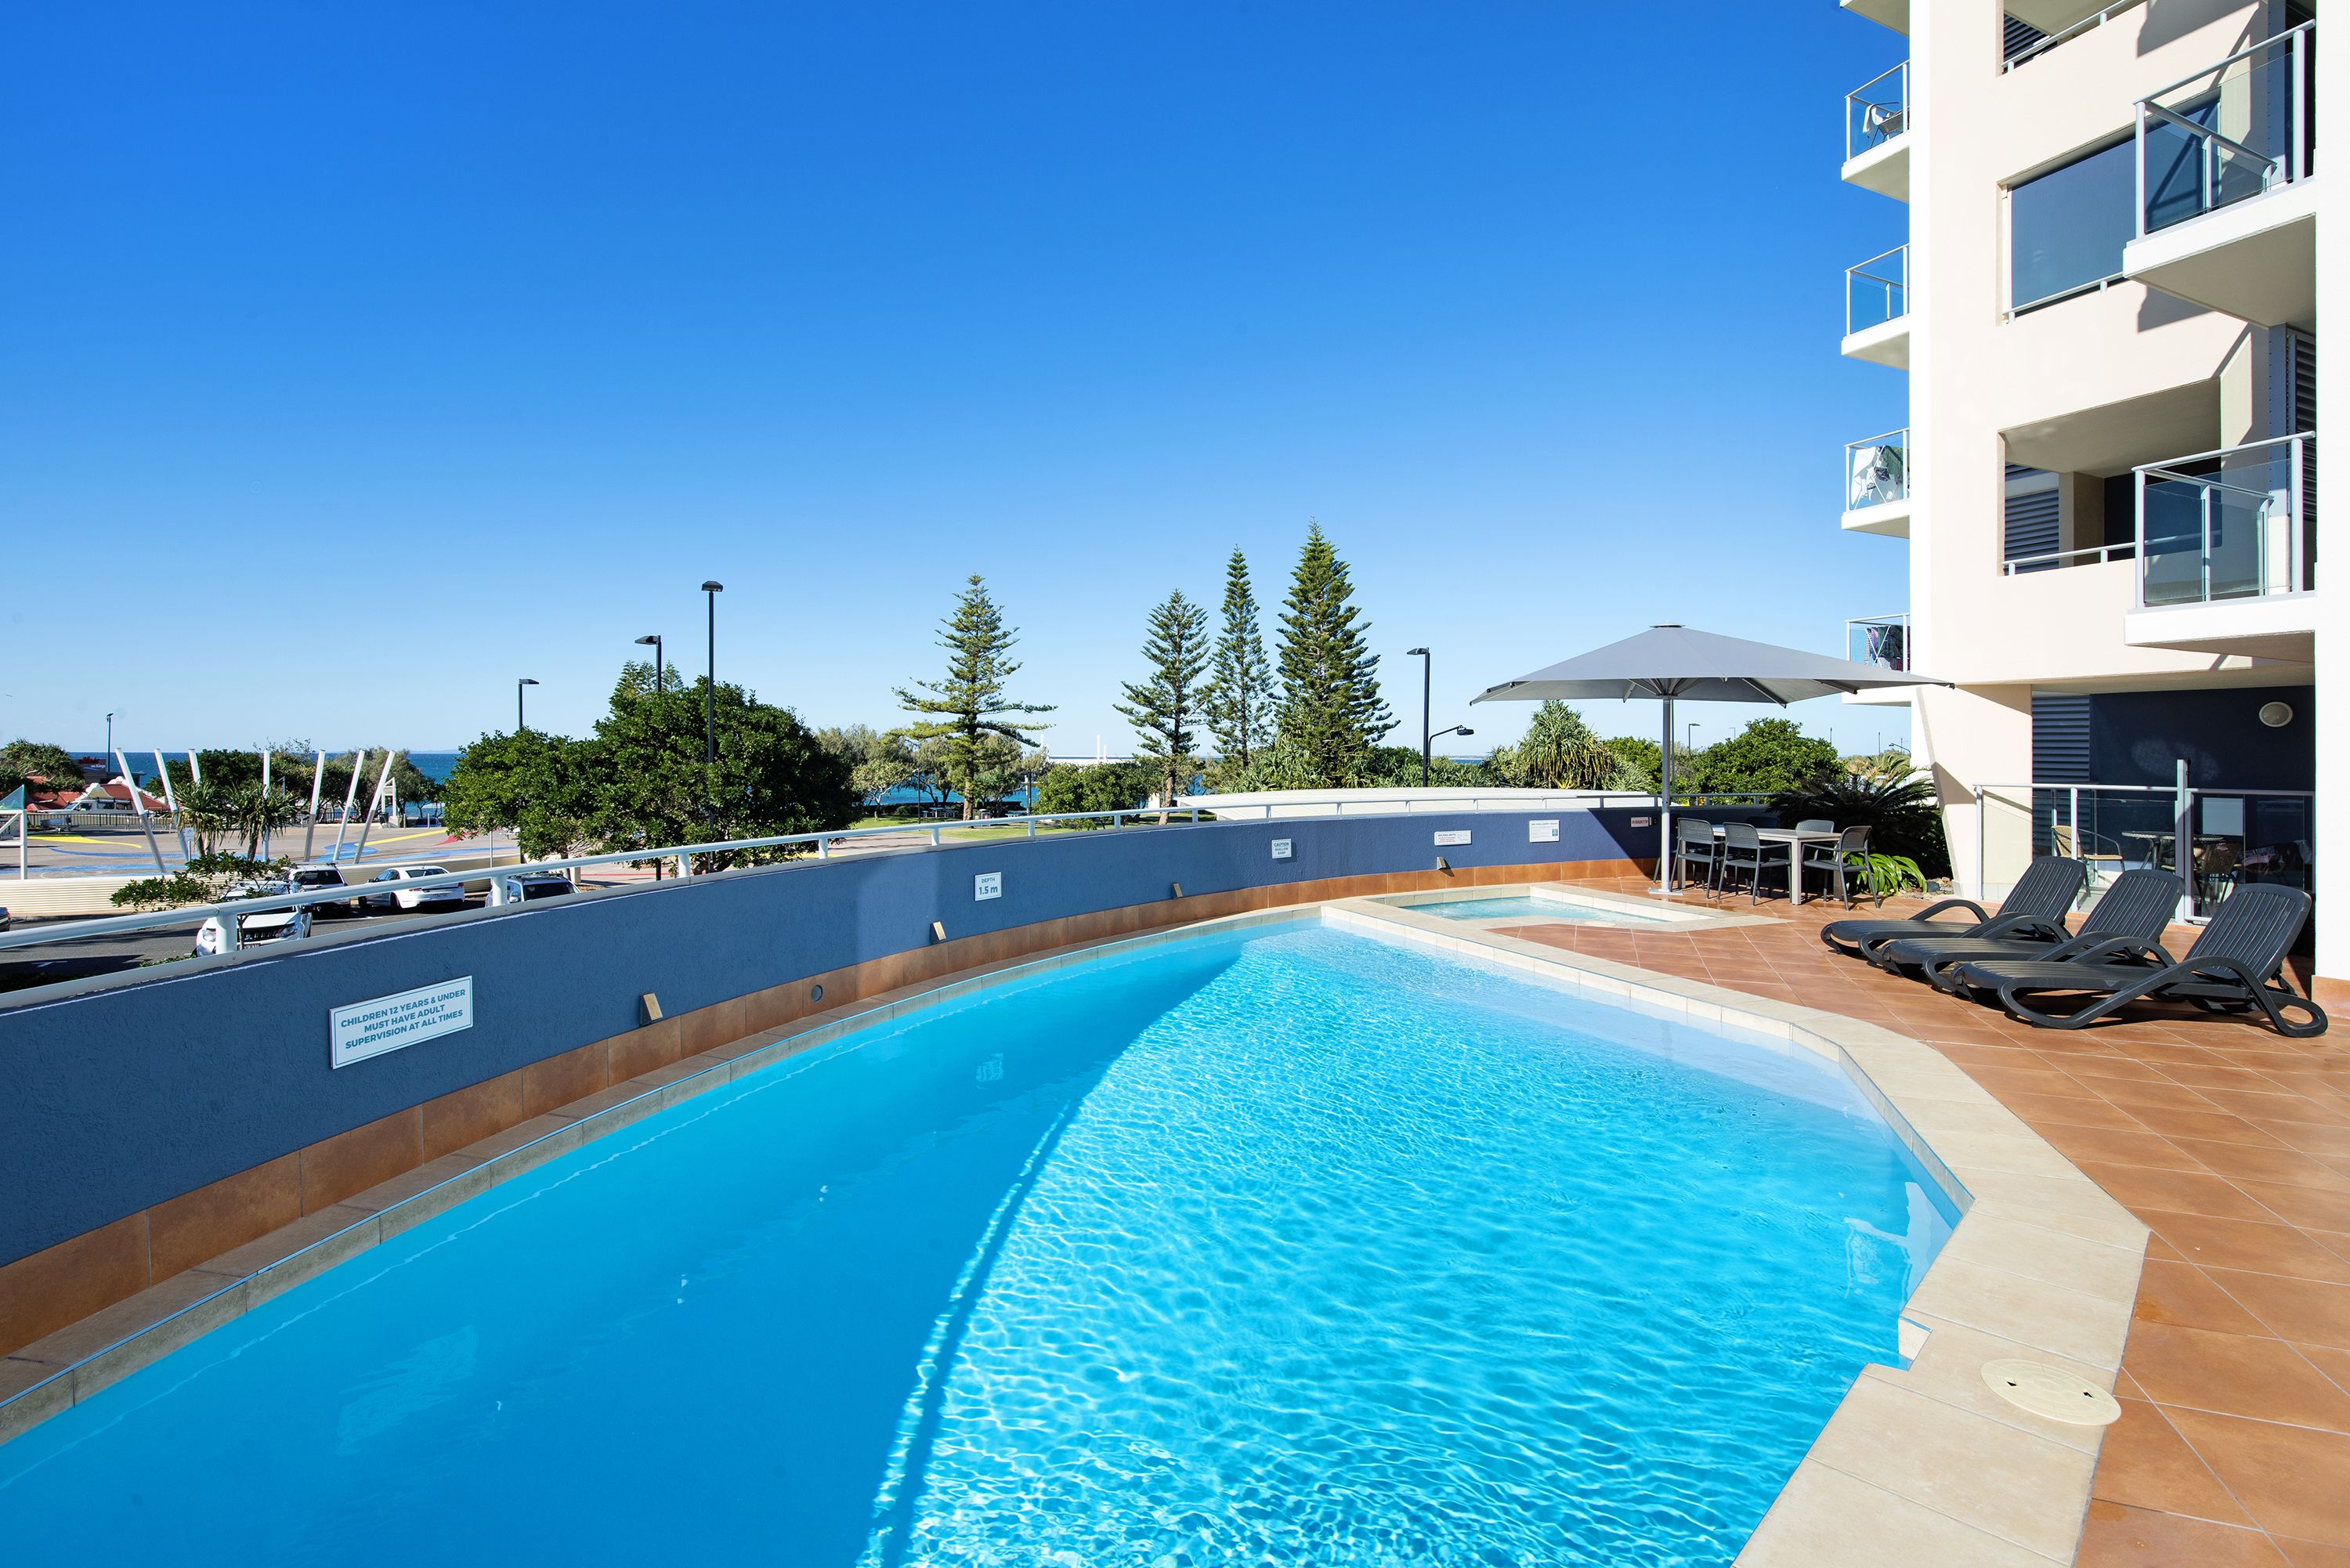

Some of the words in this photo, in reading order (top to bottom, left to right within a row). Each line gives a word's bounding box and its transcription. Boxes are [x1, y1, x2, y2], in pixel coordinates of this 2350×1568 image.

[978, 886, 989, 895] 1.5
[341, 1009, 388, 1028] CHILDREN
[389, 1006, 398, 1016] 12
[400, 998, 429, 1013] YEARS
[437, 989, 465, 1003] UNDER
[364, 1021, 390, 1033] MUST
[391, 1013, 416, 1026] HAVE
[417, 1004, 445, 1019] ADULT
[345, 1025, 407, 1050] SUPERVISION
[408, 1021, 420, 1031] AT
[421, 1017, 437, 1028] ALL
[438, 1010, 463, 1023] TIMES
